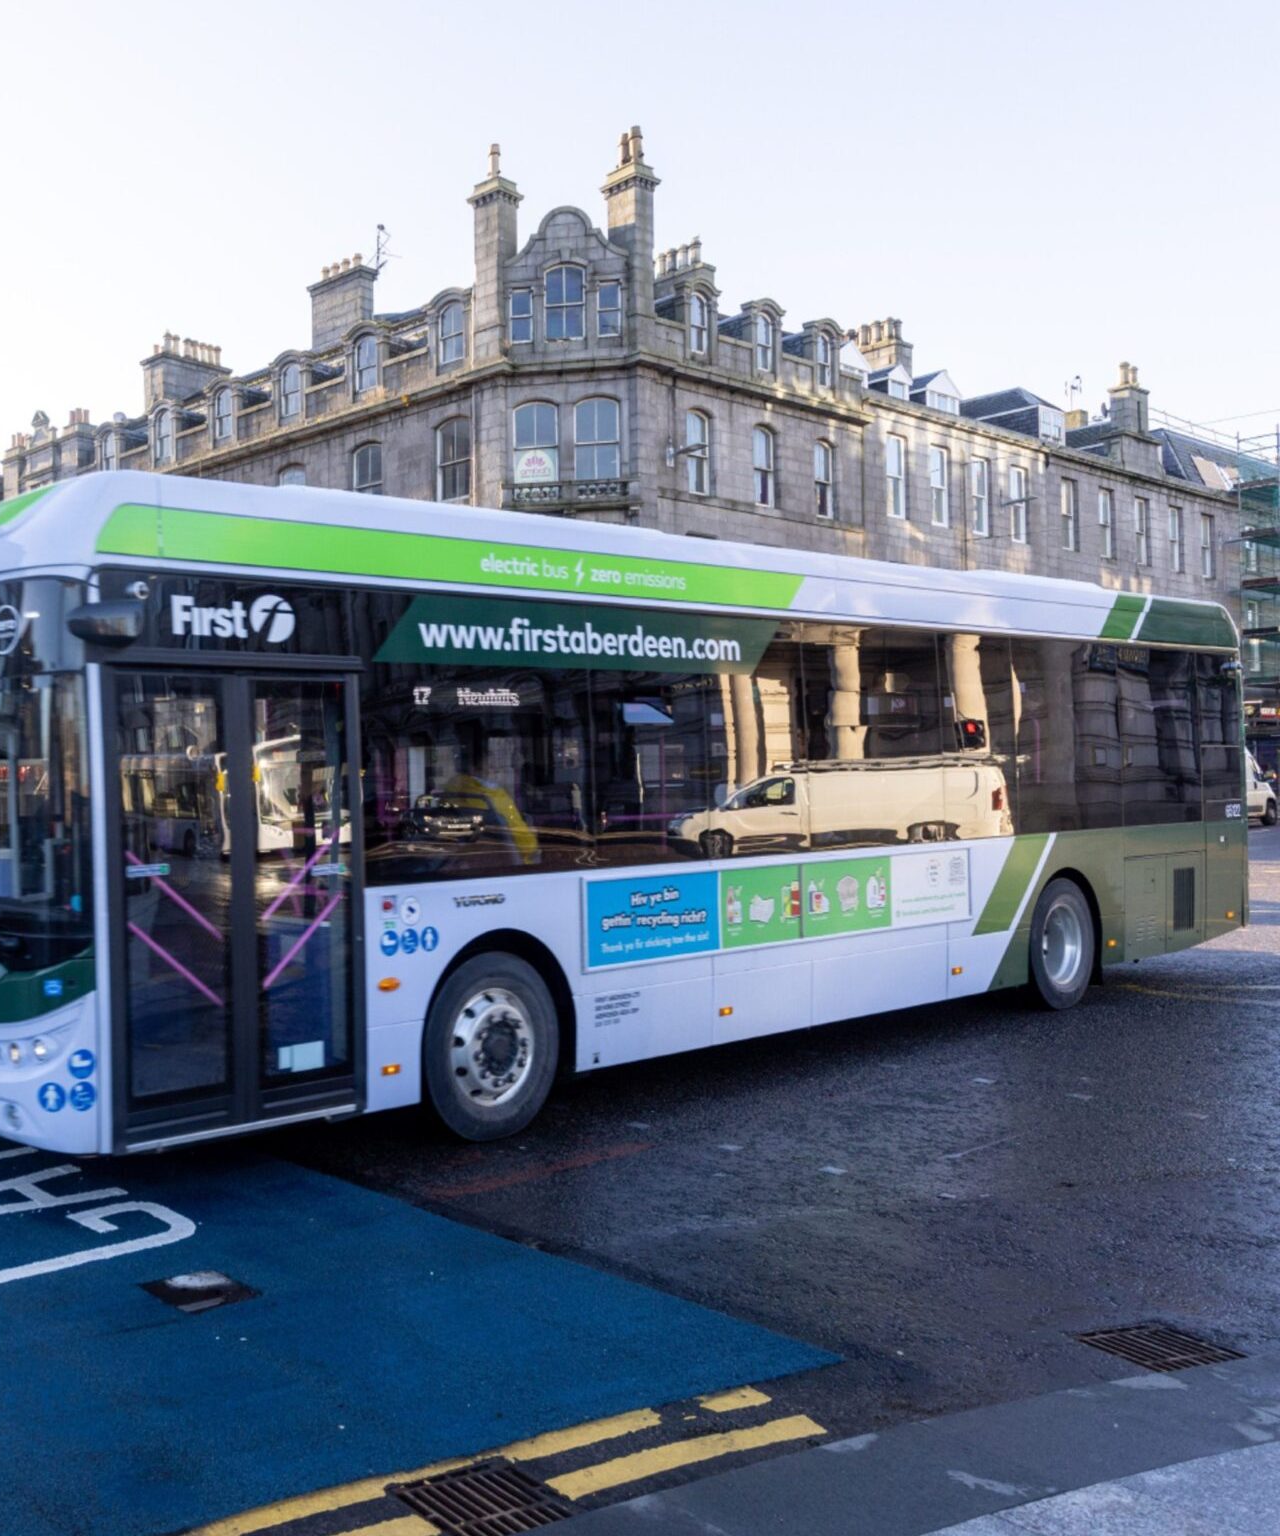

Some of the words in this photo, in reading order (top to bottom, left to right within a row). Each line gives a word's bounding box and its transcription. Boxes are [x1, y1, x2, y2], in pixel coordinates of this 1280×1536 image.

[480, 553, 539, 577] electric
[542, 559, 569, 580] bus
[590, 567, 622, 584] zero
[624, 568, 687, 591] emissions
[170, 594, 249, 639] First
[418, 617, 741, 662] www.firstaberdeen.com
[413, 686, 432, 705] 17
[631, 892, 649, 907] Hiv
[650, 893, 663, 907] ye
[663, 887, 680, 902] bin
[637, 908, 681, 927] recycling
